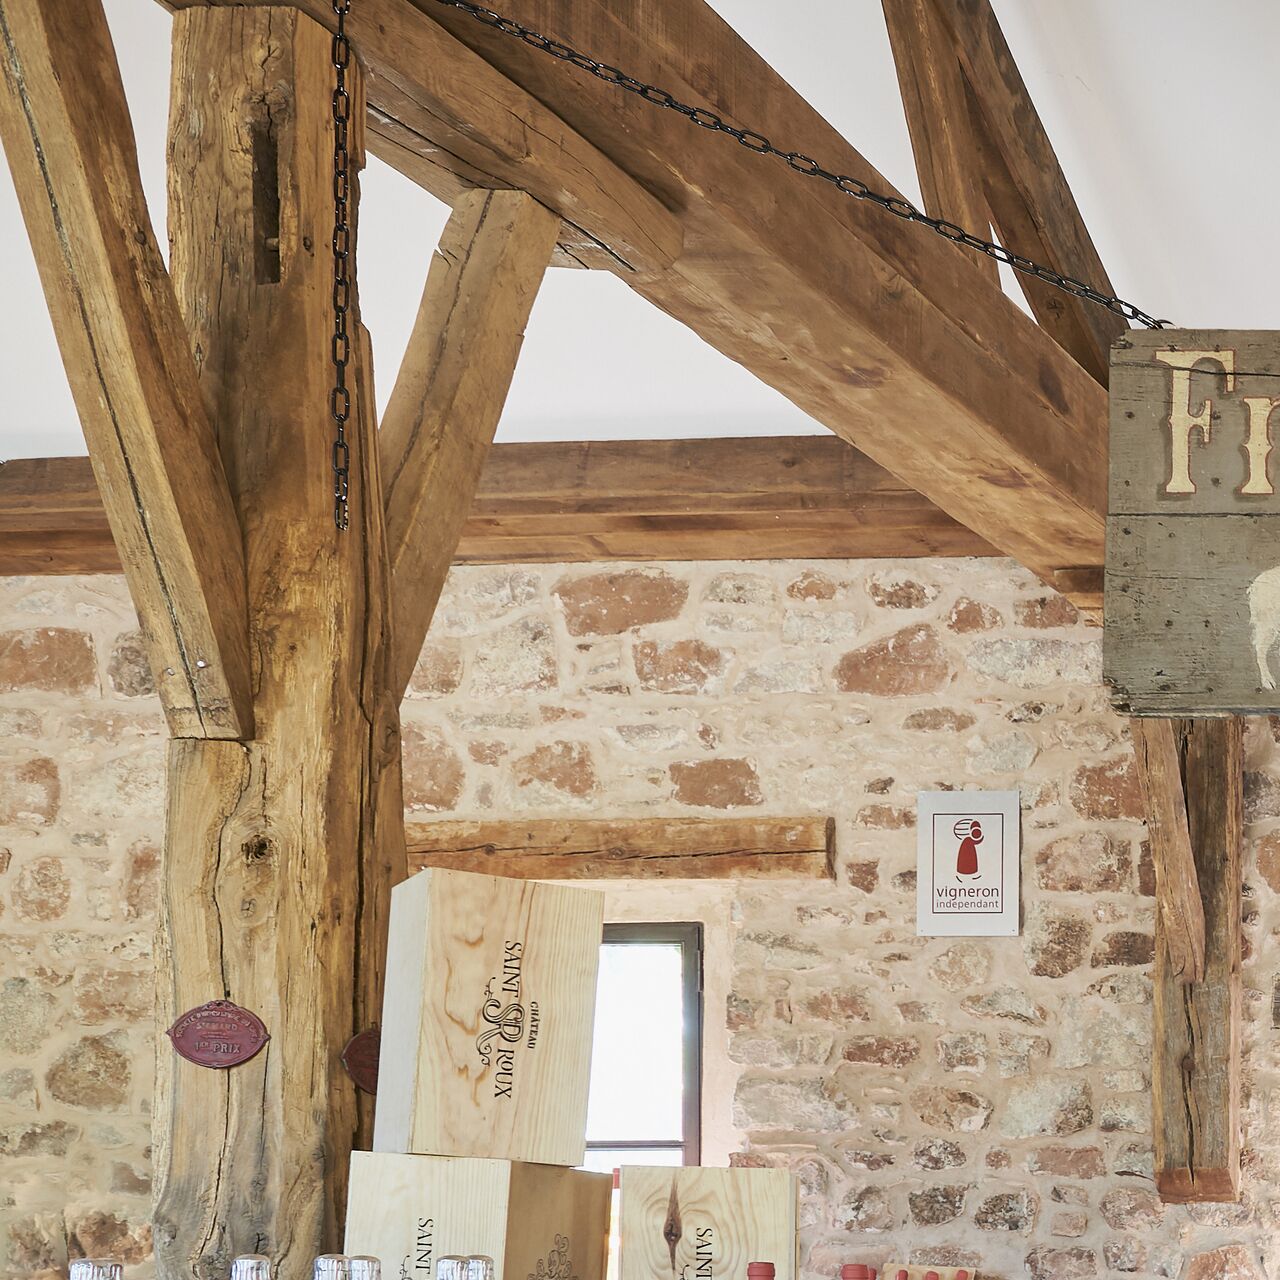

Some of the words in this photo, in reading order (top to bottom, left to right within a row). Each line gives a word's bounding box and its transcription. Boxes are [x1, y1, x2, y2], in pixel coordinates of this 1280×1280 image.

[937, 886, 999, 900] vigneron
[937, 900, 999, 909] independant
[503, 939, 523, 998] SAINT
[526, 1000, 540, 1050] CHÂTEAU
[493, 1048, 515, 1099] ROUX
